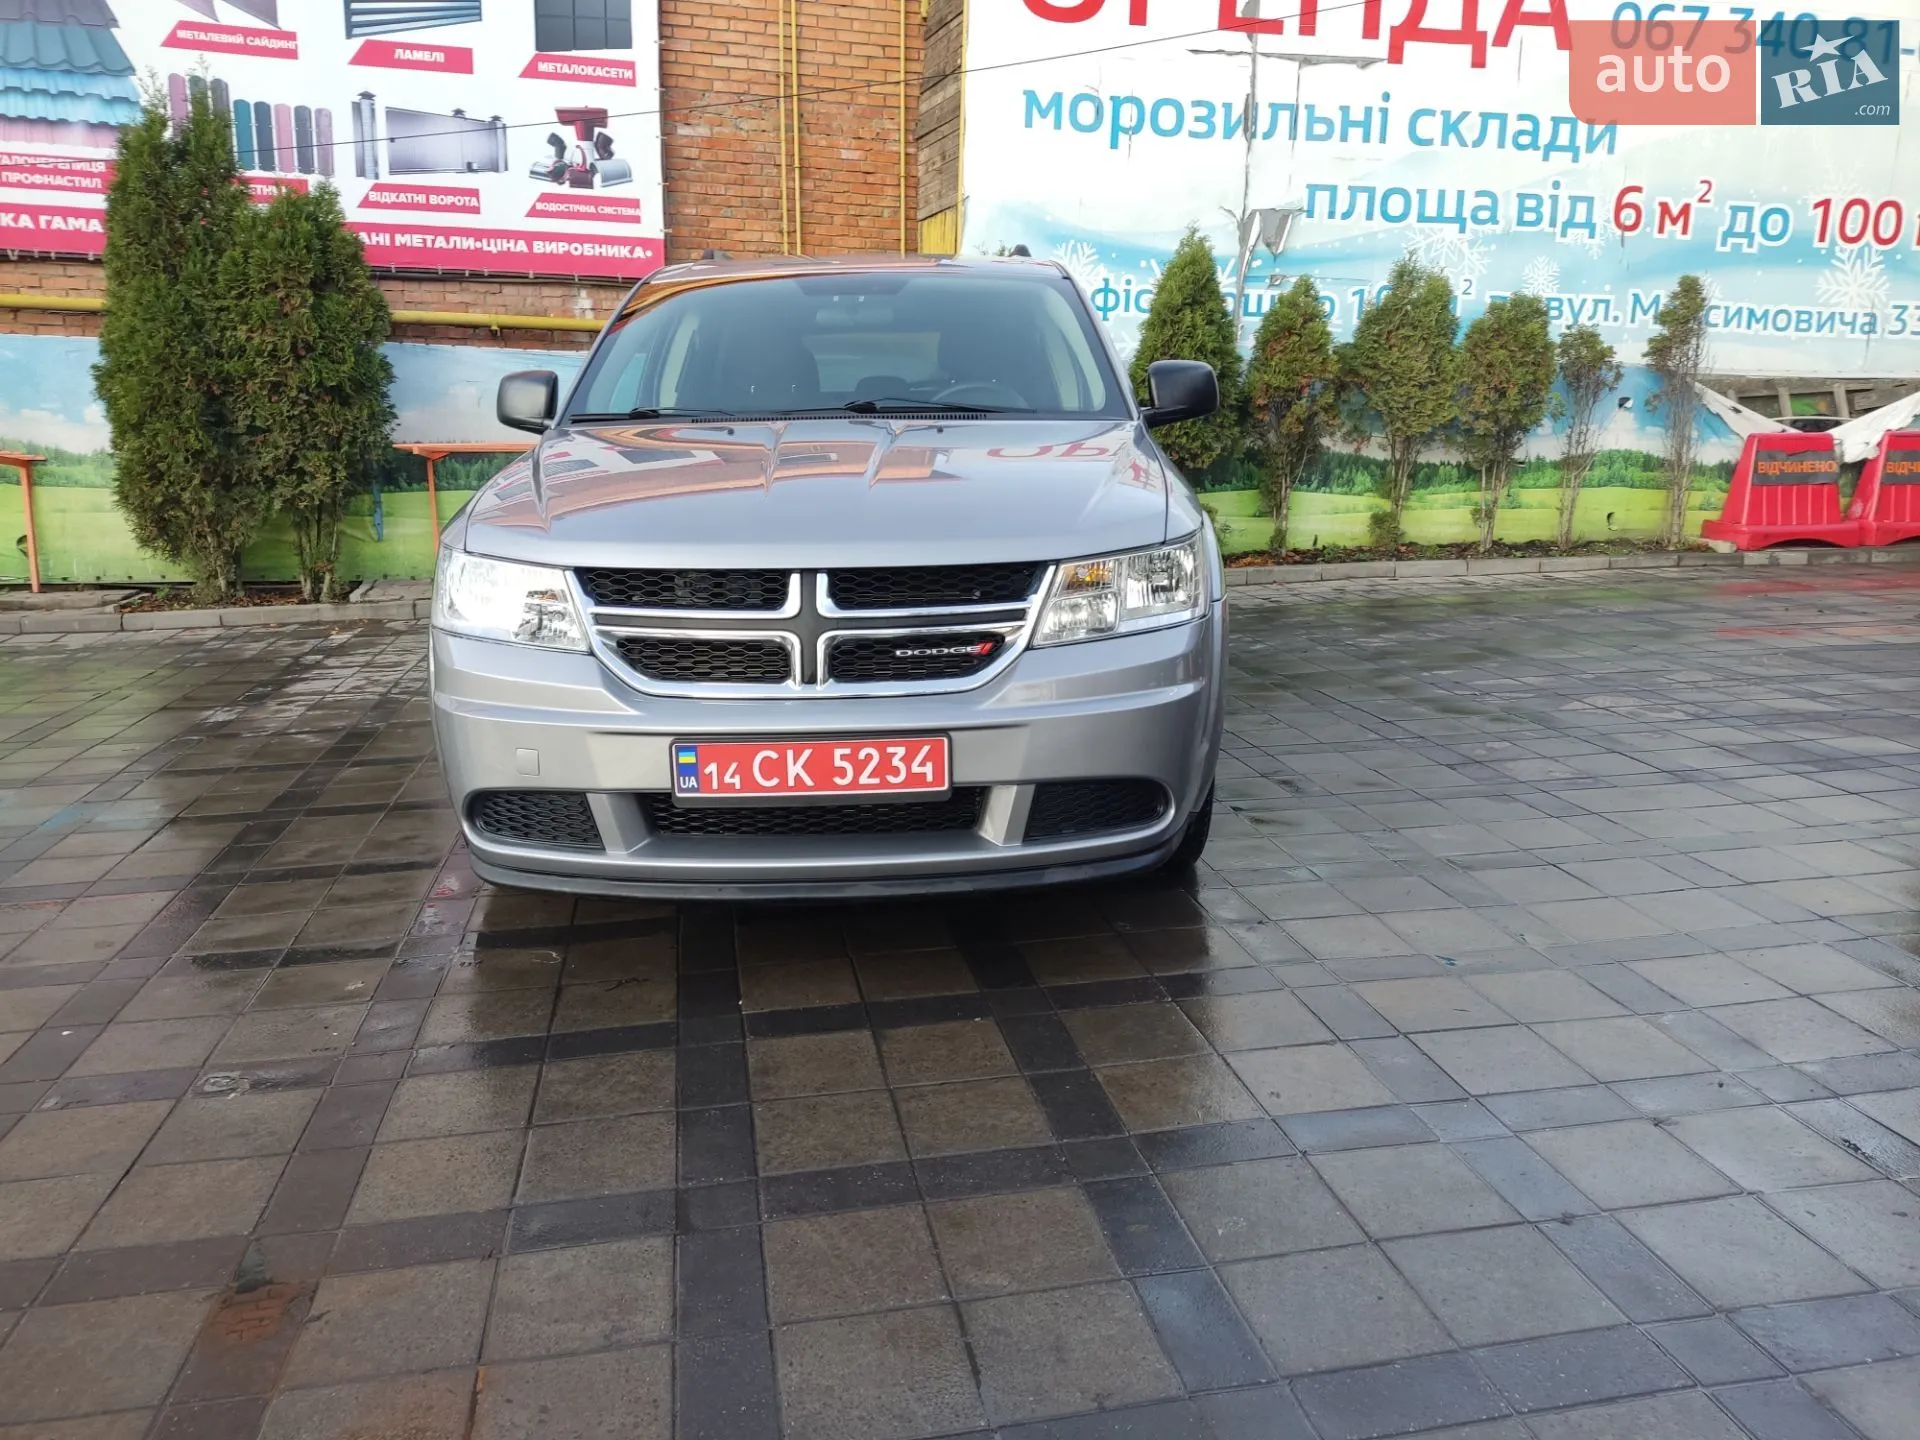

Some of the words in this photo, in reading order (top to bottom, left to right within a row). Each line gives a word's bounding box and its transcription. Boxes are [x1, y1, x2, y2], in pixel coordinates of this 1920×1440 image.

[1610, 1, 1710, 52] 067
[176, 29, 245, 45] МЕТАЛЕВИЙ
[246, 36, 298, 50] САЙДИНГ
[394, 48, 446, 63] ЛАМЕЛІ
[537, 61, 633, 80] МЕТАЛОКАСЕТИ
[1022, 89, 1391, 150] морозильні
[1407, 106, 1618, 163] склади
[1, 171, 102, 189] ПРОФНАСТИЛ
[368, 191, 427, 205] ВІДКАТНІ
[428, 194, 480, 208] ВОРОТА
[38, 214, 105, 233] ГАМА
[1305, 183, 1499, 234] площа
[1515, 180, 1596, 238] від
[1721, 203, 1791, 249] до
[1812, 197, 1904, 246] 100
[1630, 292, 1877, 336] Мсимовича
[1757, 460, 1838, 476] ВІДЧИНЕНО
[895, 645, 983, 657] DODGE
[703, 762, 742, 791] 14
[752, 748, 816, 788] CK
[832, 744, 935, 787] 5234
[680, 776, 698, 790] UA
